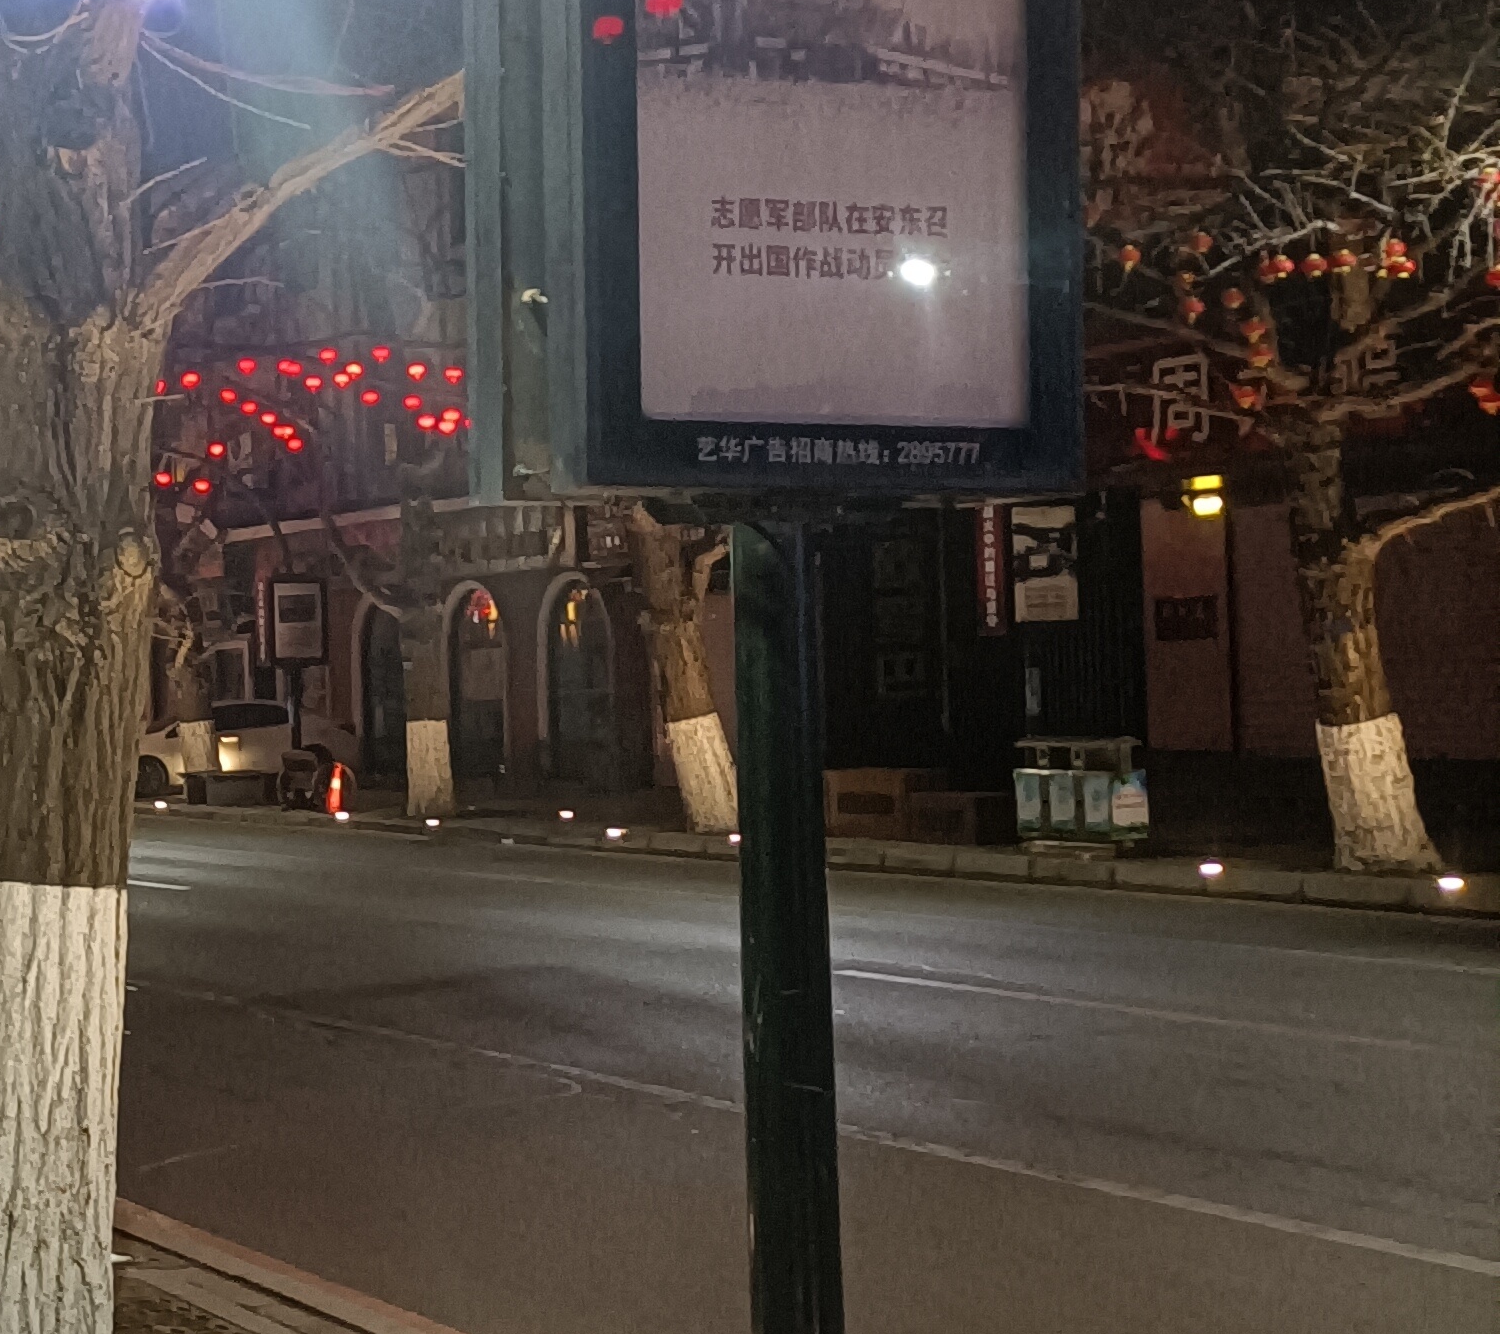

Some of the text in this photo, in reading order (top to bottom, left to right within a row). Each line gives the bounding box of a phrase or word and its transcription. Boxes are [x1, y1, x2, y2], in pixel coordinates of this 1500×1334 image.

[711, 195, 948, 238] 志愿军部队在安东召
[712, 242, 947, 280] 开出国作战动员
